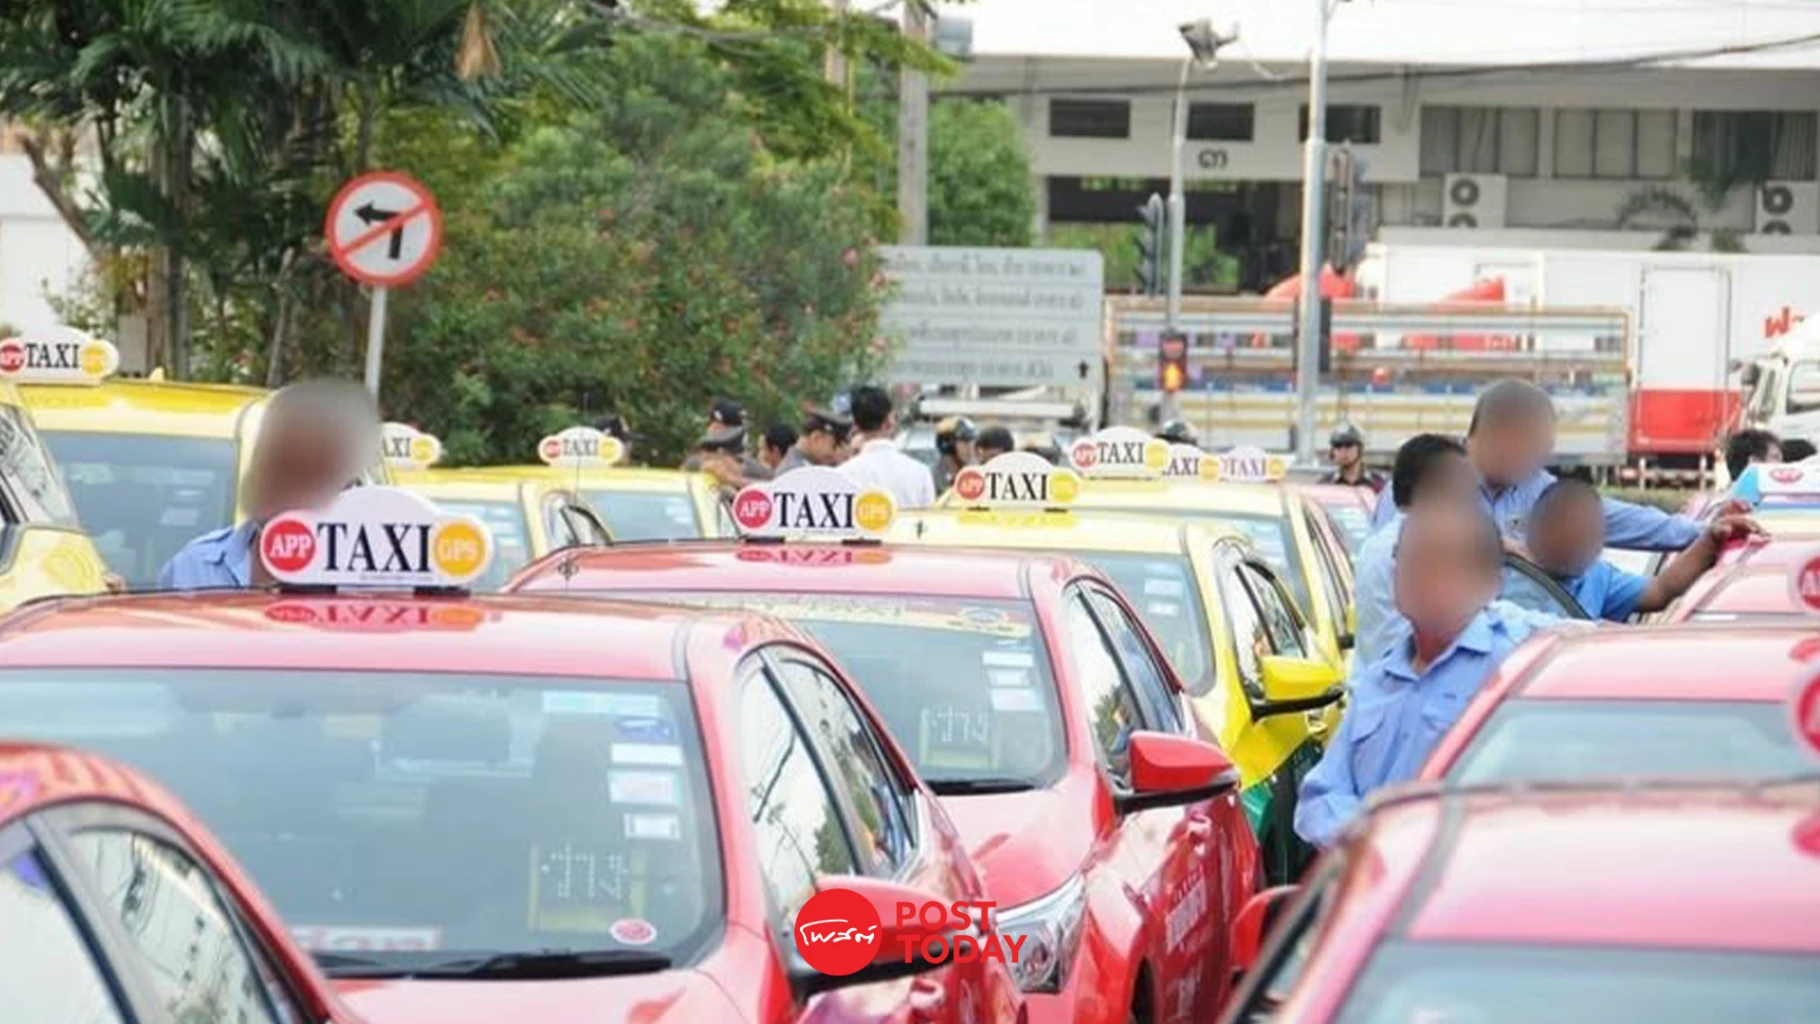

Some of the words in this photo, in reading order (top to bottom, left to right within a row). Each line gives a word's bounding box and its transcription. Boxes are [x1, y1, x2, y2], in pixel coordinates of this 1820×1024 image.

[25, 343, 79, 368] TAXI
[562, 438, 599, 456] TAXI
[1097, 442, 1144, 463] TAXI
[1228, 457, 1267, 476] TAXI
[986, 472, 1047, 500] TAXI
[739, 500, 770, 518] APP
[773, 492, 855, 528] TAXI
[270, 534, 312, 559] APP
[317, 522, 432, 572] TAXI
[438, 538, 477, 560] GPS
[541, 843, 628, 899] ว่าง
